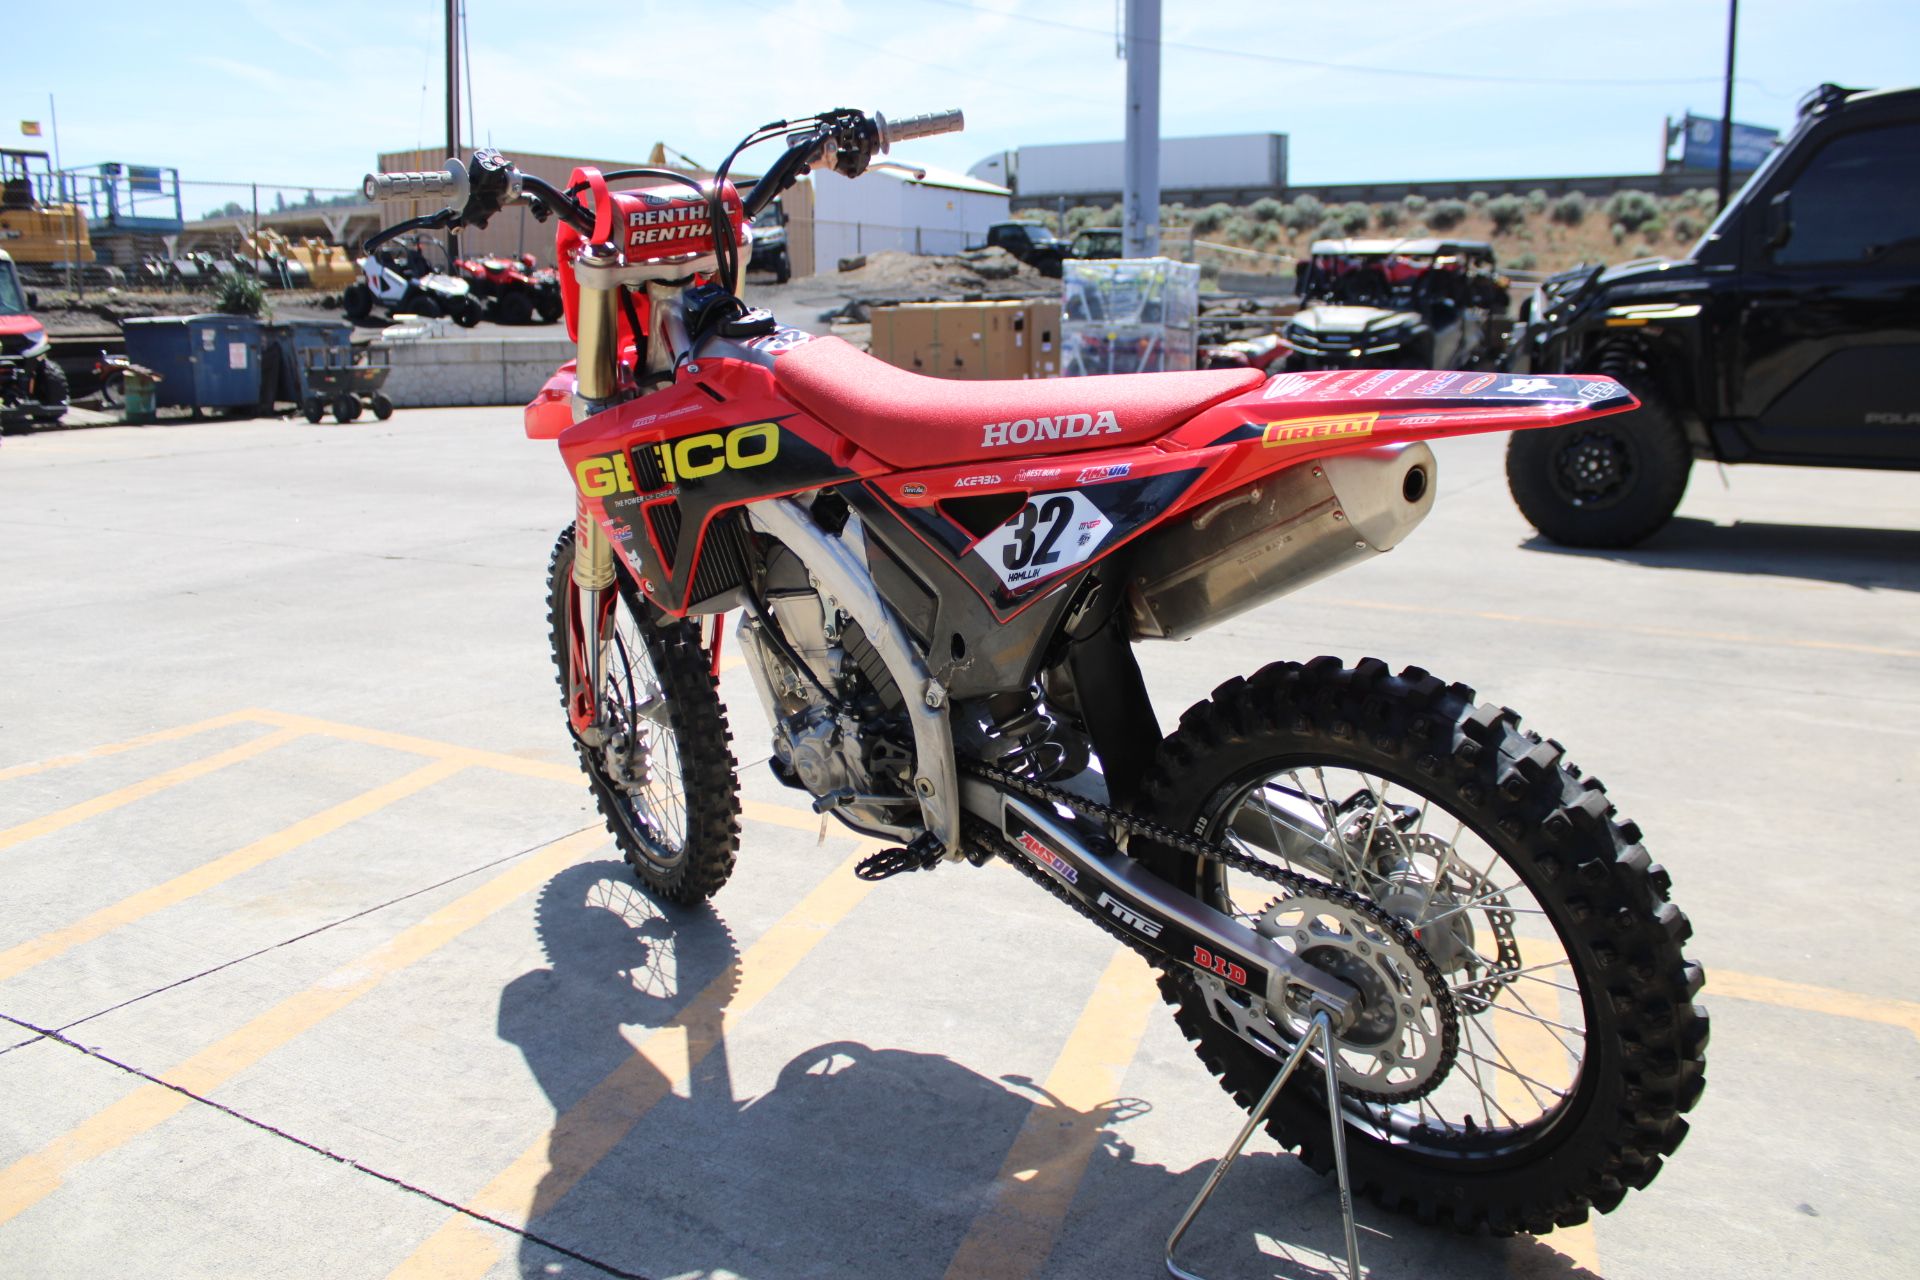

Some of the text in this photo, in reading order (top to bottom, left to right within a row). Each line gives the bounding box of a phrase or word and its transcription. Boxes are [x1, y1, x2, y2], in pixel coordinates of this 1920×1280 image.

[629, 201, 735, 227] RENTHL
[980, 410, 1122, 447] HONDA
[1266, 416, 1370, 444] PIRELLI
[954, 474, 1002, 487] ACERBIS
[1077, 463, 1132, 483] AMSOIL
[614, 500, 624, 508] THE
[624, 495, 643, 507] POWER
[1002, 496, 1075, 571] 32
[1016, 831, 1078, 884] AMSOIL
